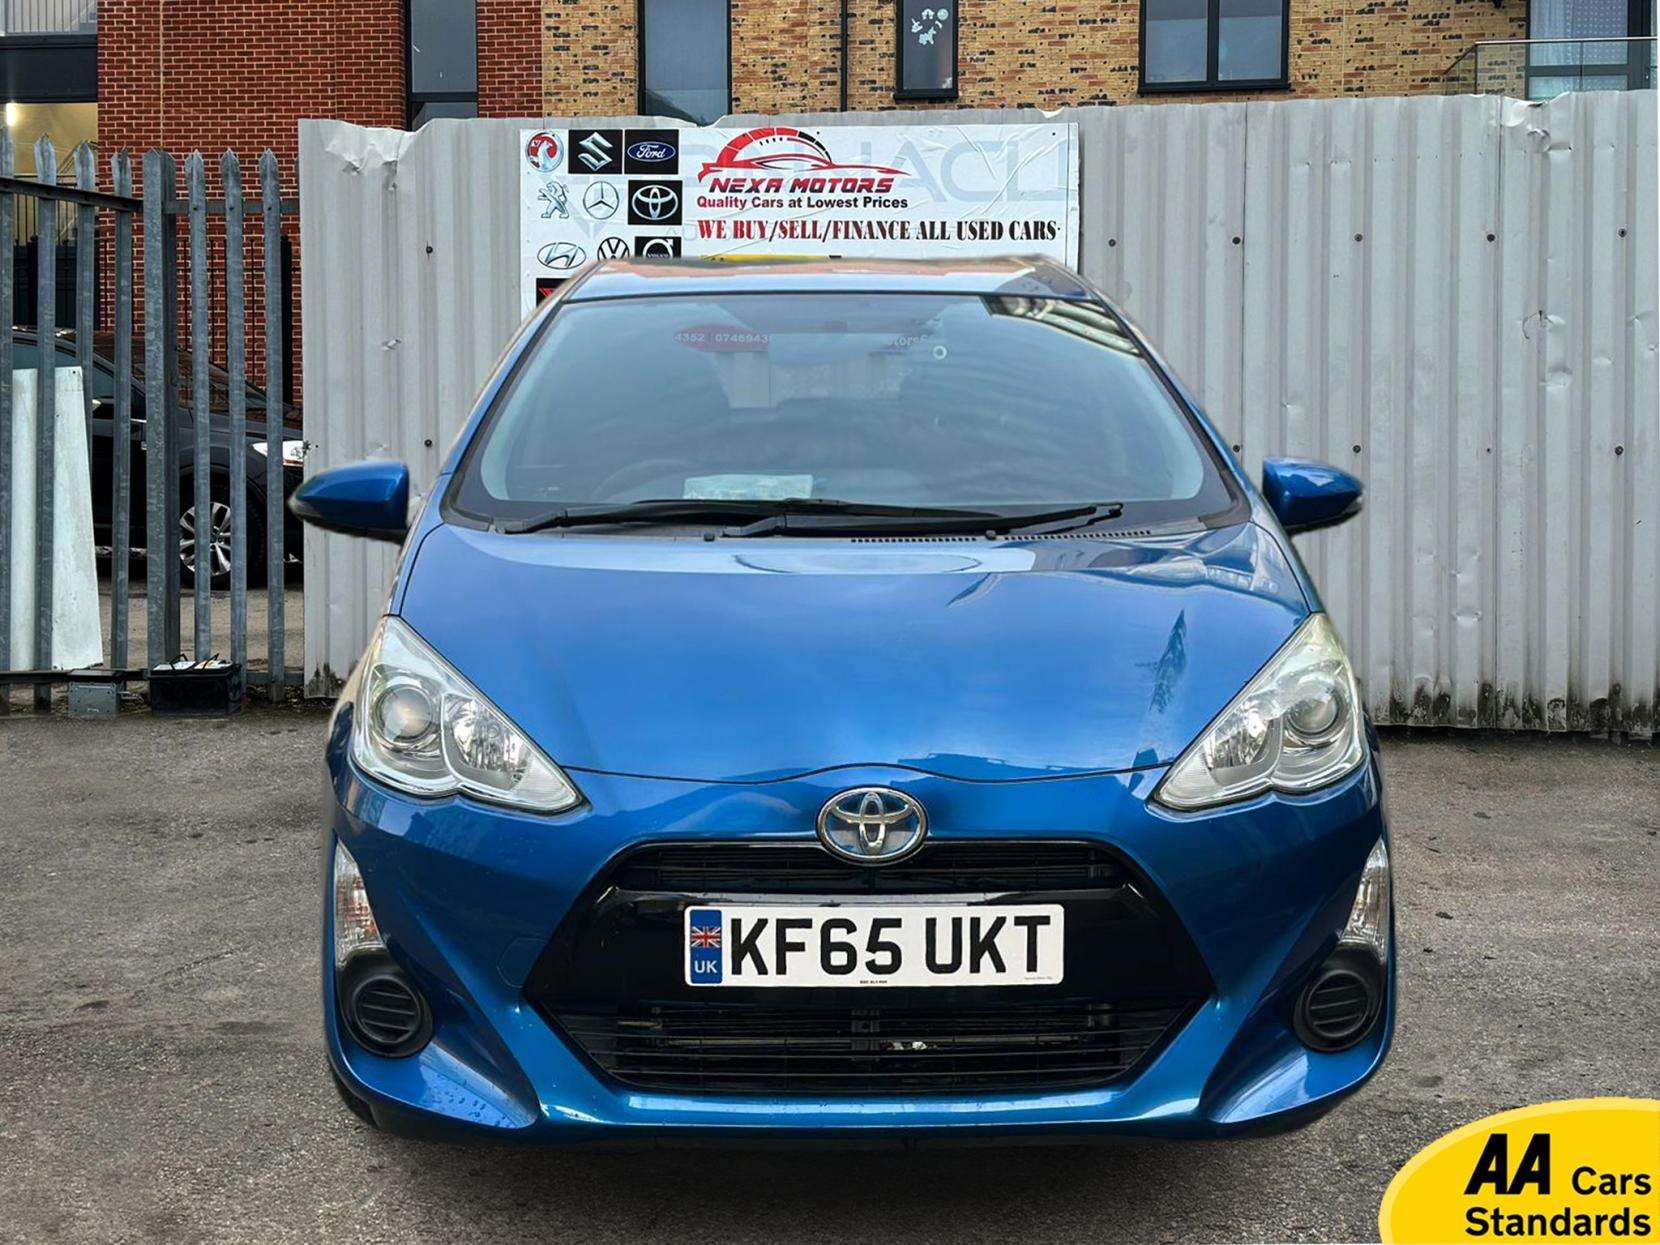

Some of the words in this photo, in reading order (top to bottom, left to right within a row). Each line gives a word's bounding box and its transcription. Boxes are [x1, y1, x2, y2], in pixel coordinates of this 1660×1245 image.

[636, 143, 666, 158] Ford
[709, 178, 783, 193] NEXA
[789, 178, 894, 193] MOTORS
[697, 196, 746, 209] Quality
[751, 196, 784, 208] Cars
[788, 197, 802, 208] at
[807, 197, 858, 208] Lowest
[862, 197, 908, 208] Prices
[697, 220, 727, 239] WE
[733, 219, 911, 242] BUY/SELL/FINANCE
[916, 220, 951, 240] ALL
[956, 220, 1004, 240] USED
[731, 918, 902, 975] KF65
[925, 915, 1051, 974] UKT
[694, 960, 717, 974] UK
